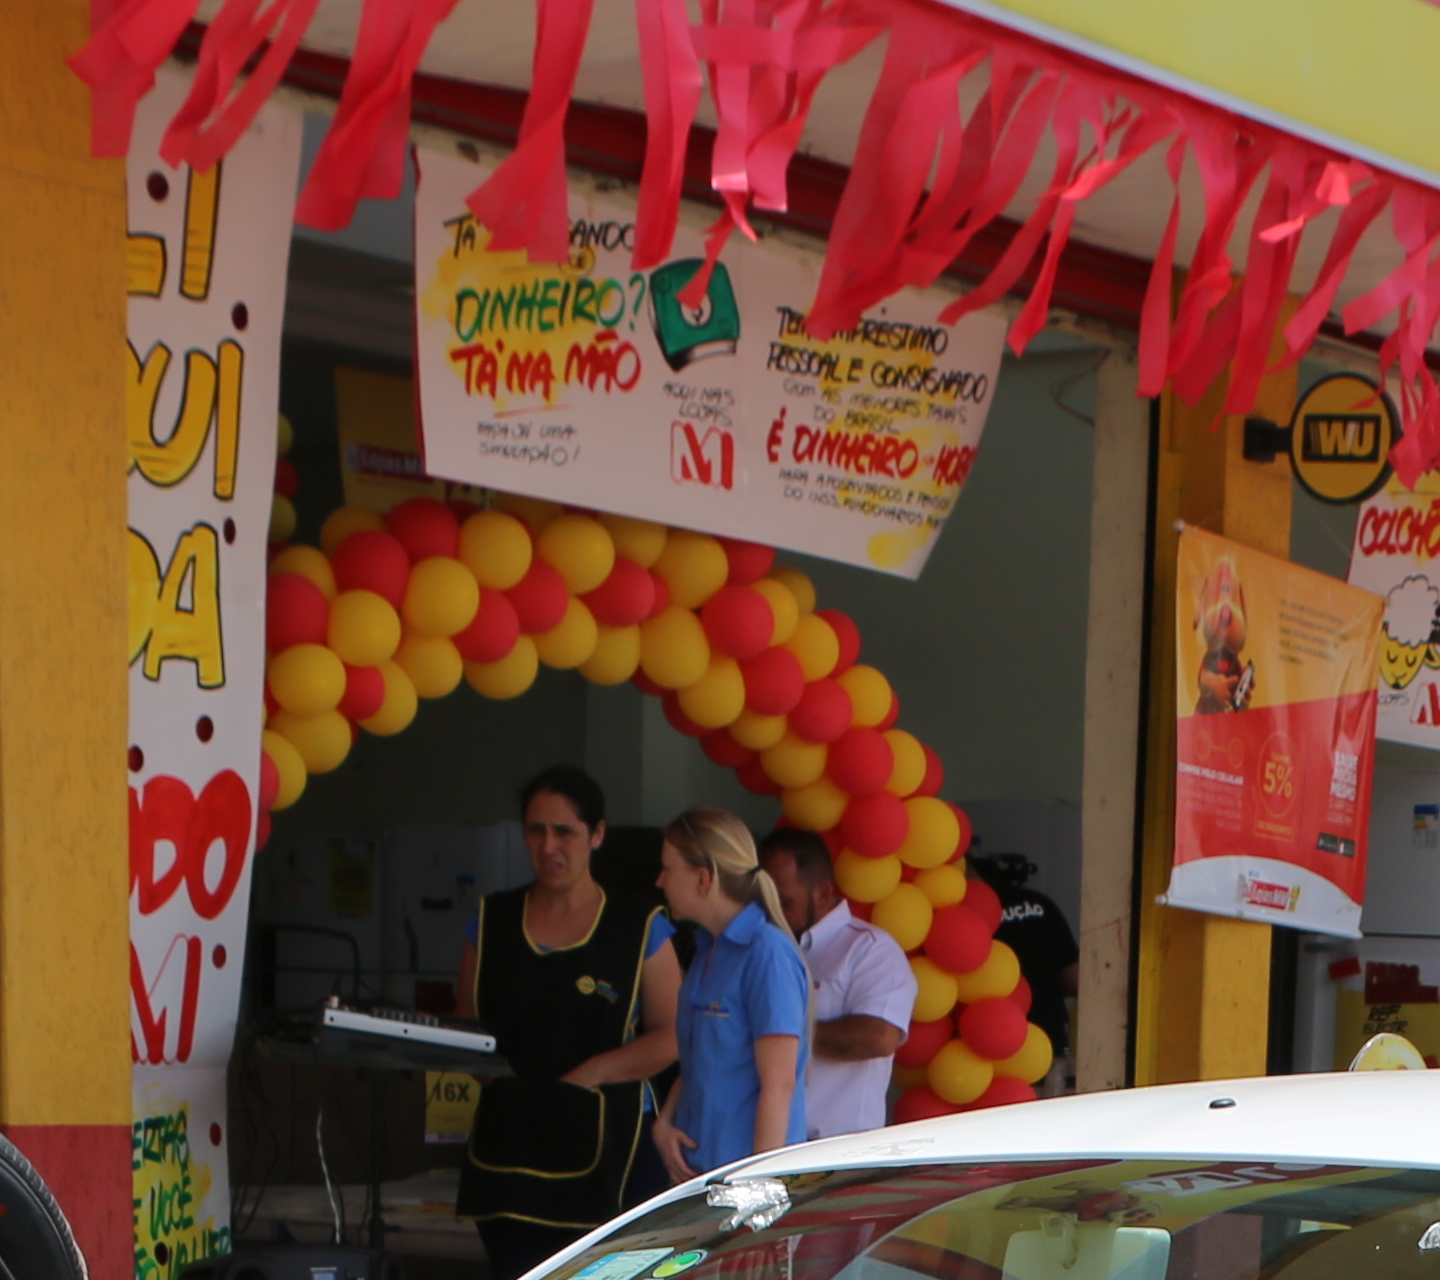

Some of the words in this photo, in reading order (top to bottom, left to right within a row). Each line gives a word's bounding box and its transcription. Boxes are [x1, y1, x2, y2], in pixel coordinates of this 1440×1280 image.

[455, 273, 647, 342] DINHEIRO?
[792, 424, 920, 480] DINHEIRO
[1263, 761, 1293, 798] 5%
[1001, 900, 1045, 921] UÇÃO
